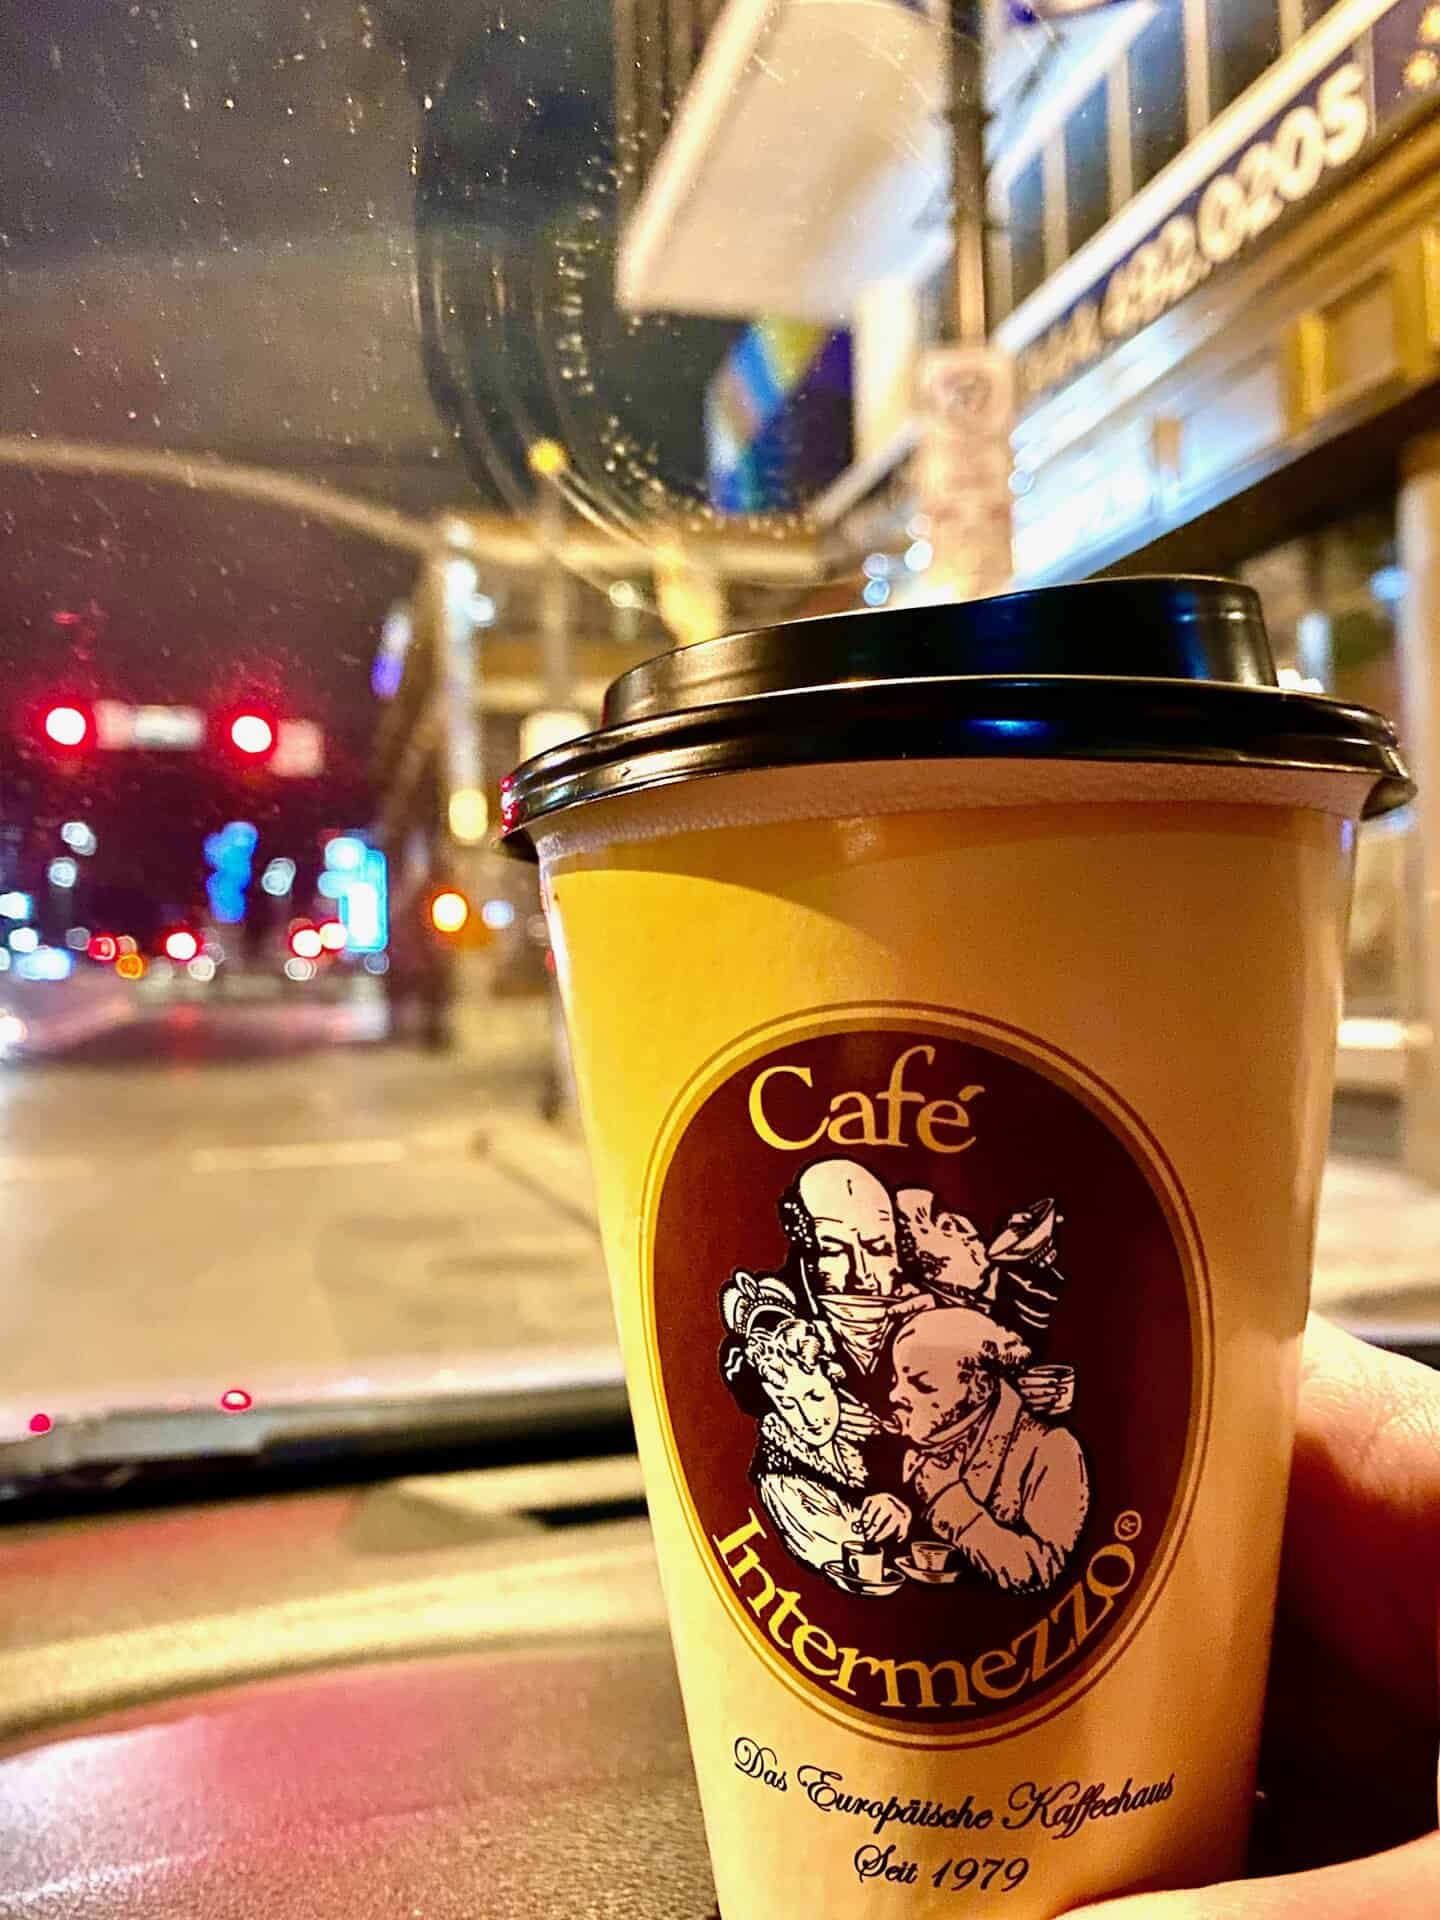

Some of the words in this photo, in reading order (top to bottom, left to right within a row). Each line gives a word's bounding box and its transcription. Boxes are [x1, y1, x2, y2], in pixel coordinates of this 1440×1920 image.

[748, 1044, 986, 1154] Café
[734, 1736, 788, 1792] Das
[797, 1765, 994, 1834] Europäische
[1002, 1772, 1176, 1840] Kaffeehaus
[853, 1845, 919, 1883] Seit
[931, 1857, 1030, 1892] 1979
